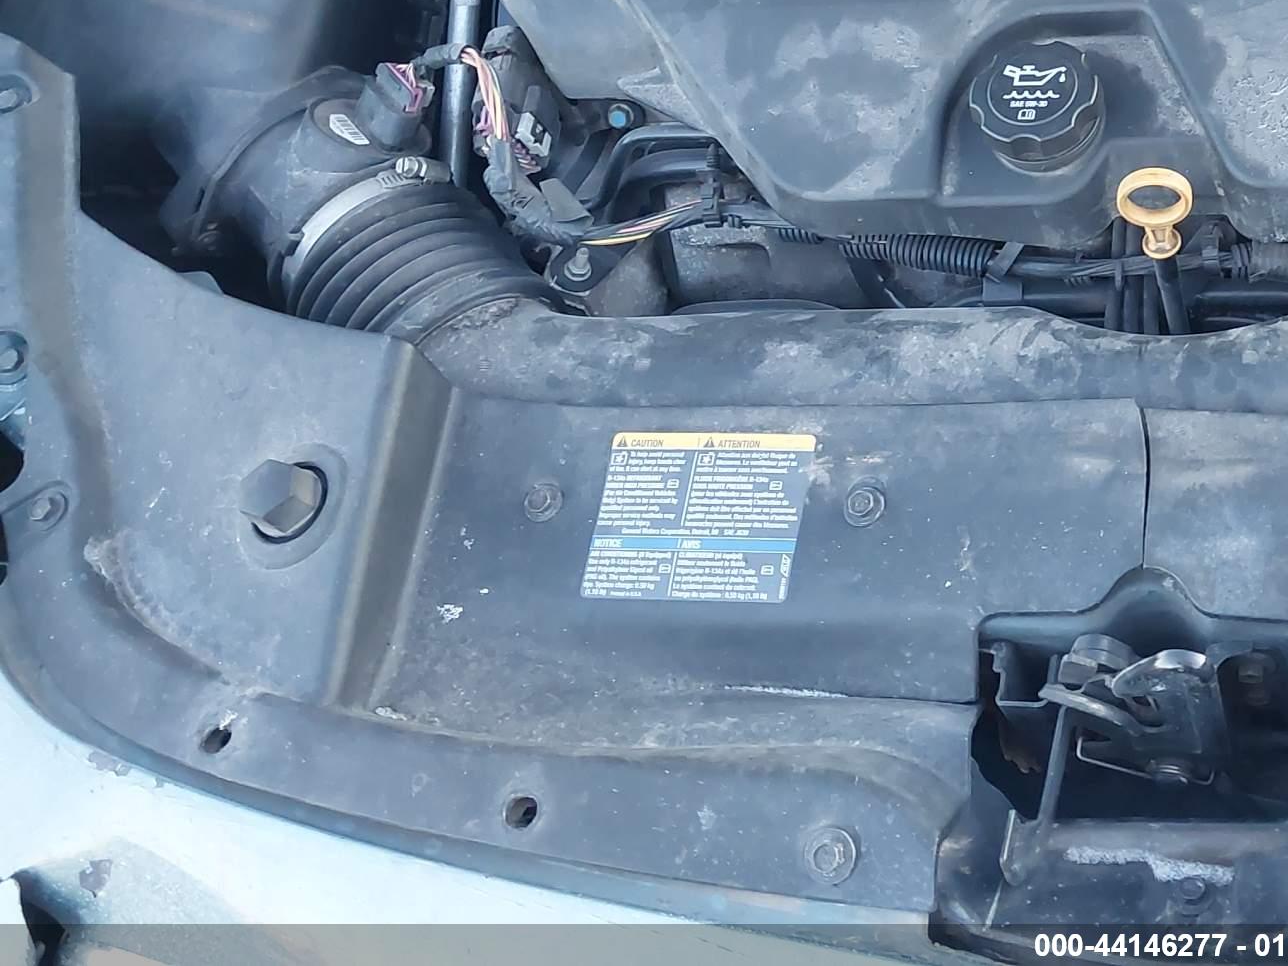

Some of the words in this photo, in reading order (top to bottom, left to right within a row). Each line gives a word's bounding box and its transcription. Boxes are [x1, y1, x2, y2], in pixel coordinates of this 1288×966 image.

[631, 439, 664, 447] CAUTION
[718, 439, 760, 448] ATTENTION
[594, 538, 623, 547] NOTICE
[681, 539, 702, 549] AVIS
